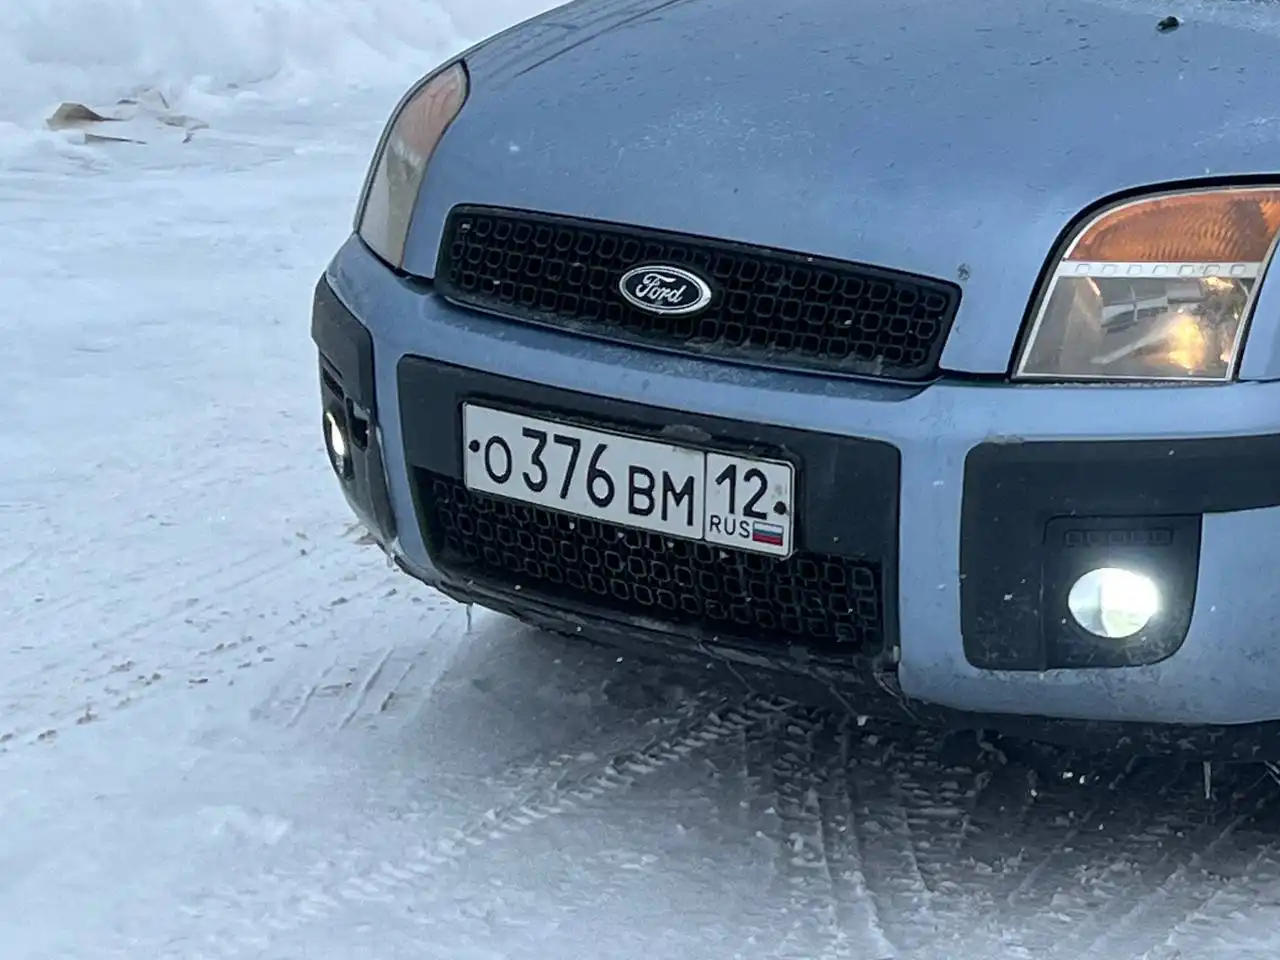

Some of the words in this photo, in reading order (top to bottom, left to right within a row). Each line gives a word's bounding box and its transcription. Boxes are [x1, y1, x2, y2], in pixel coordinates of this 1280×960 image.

[635, 273, 687, 303] Ford
[715, 464, 768, 520] 12
[709, 514, 751, 538] RUS
